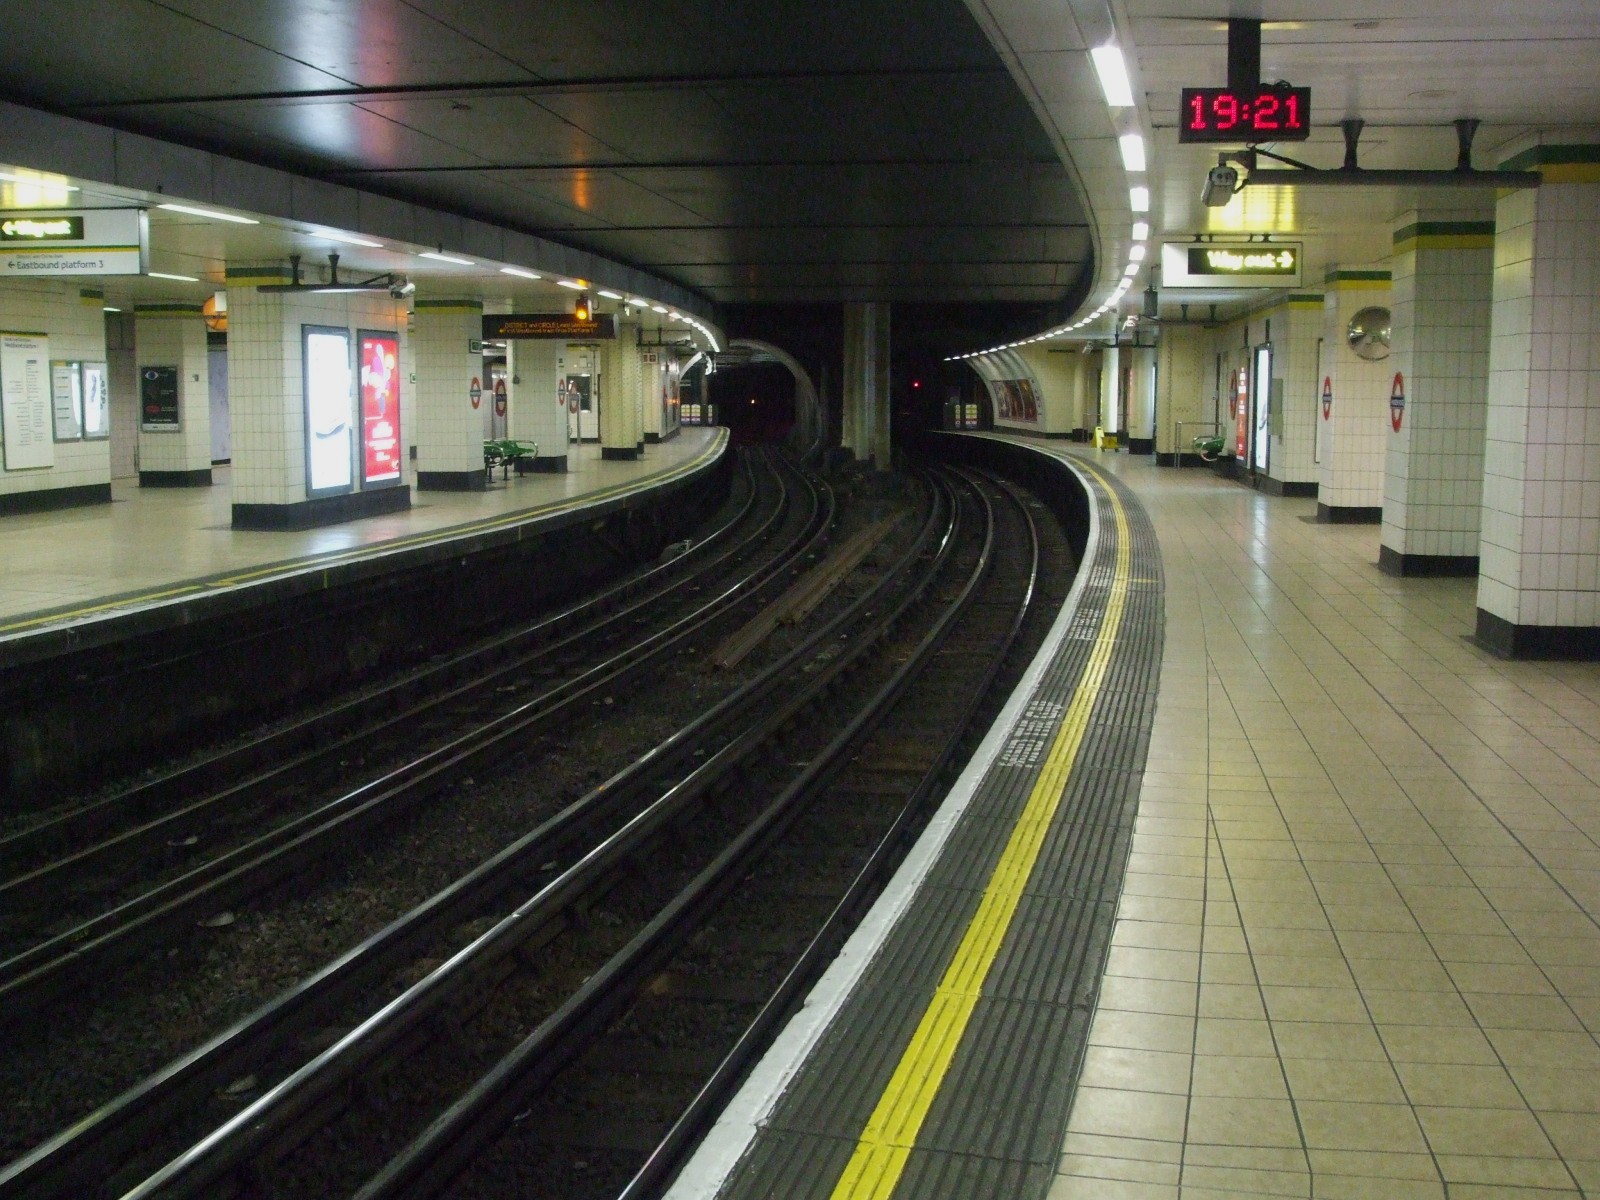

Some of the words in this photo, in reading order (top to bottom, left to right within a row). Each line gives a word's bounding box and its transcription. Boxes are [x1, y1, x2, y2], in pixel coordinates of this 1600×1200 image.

[1190, 95, 1301, 129] 19:21
[17, 261, 59, 270] Eastbound
[61, 260, 96, 270] platform
[98, 260, 103, 268] 3
[1206, 250, 1243, 271] Way
[1244, 253, 1276, 268] out
